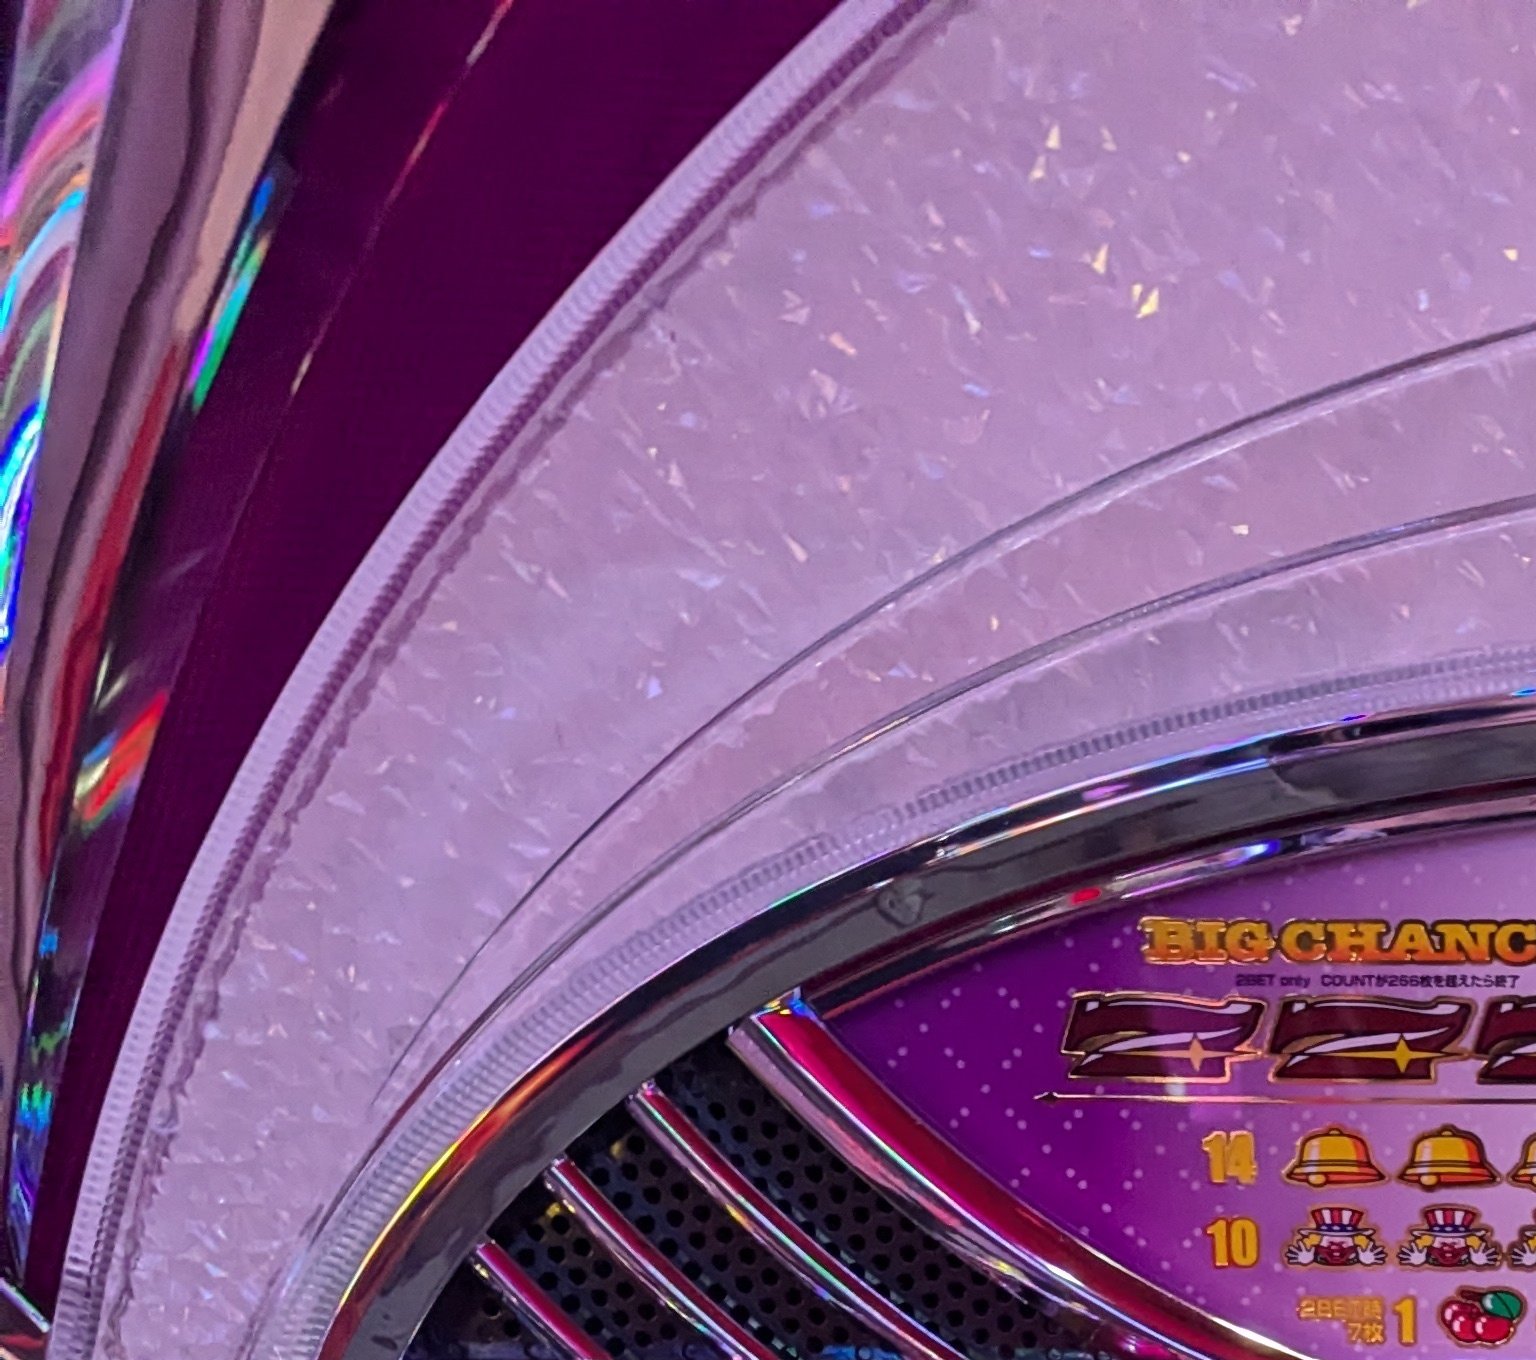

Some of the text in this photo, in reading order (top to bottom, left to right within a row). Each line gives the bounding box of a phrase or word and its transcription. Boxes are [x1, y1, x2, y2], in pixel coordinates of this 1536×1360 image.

[1141, 916, 1275, 965] BIG
[1201, 1130, 1258, 1185] 14
[1205, 1218, 1259, 1268] 10
[1393, 1296, 1416, 1345] 1
